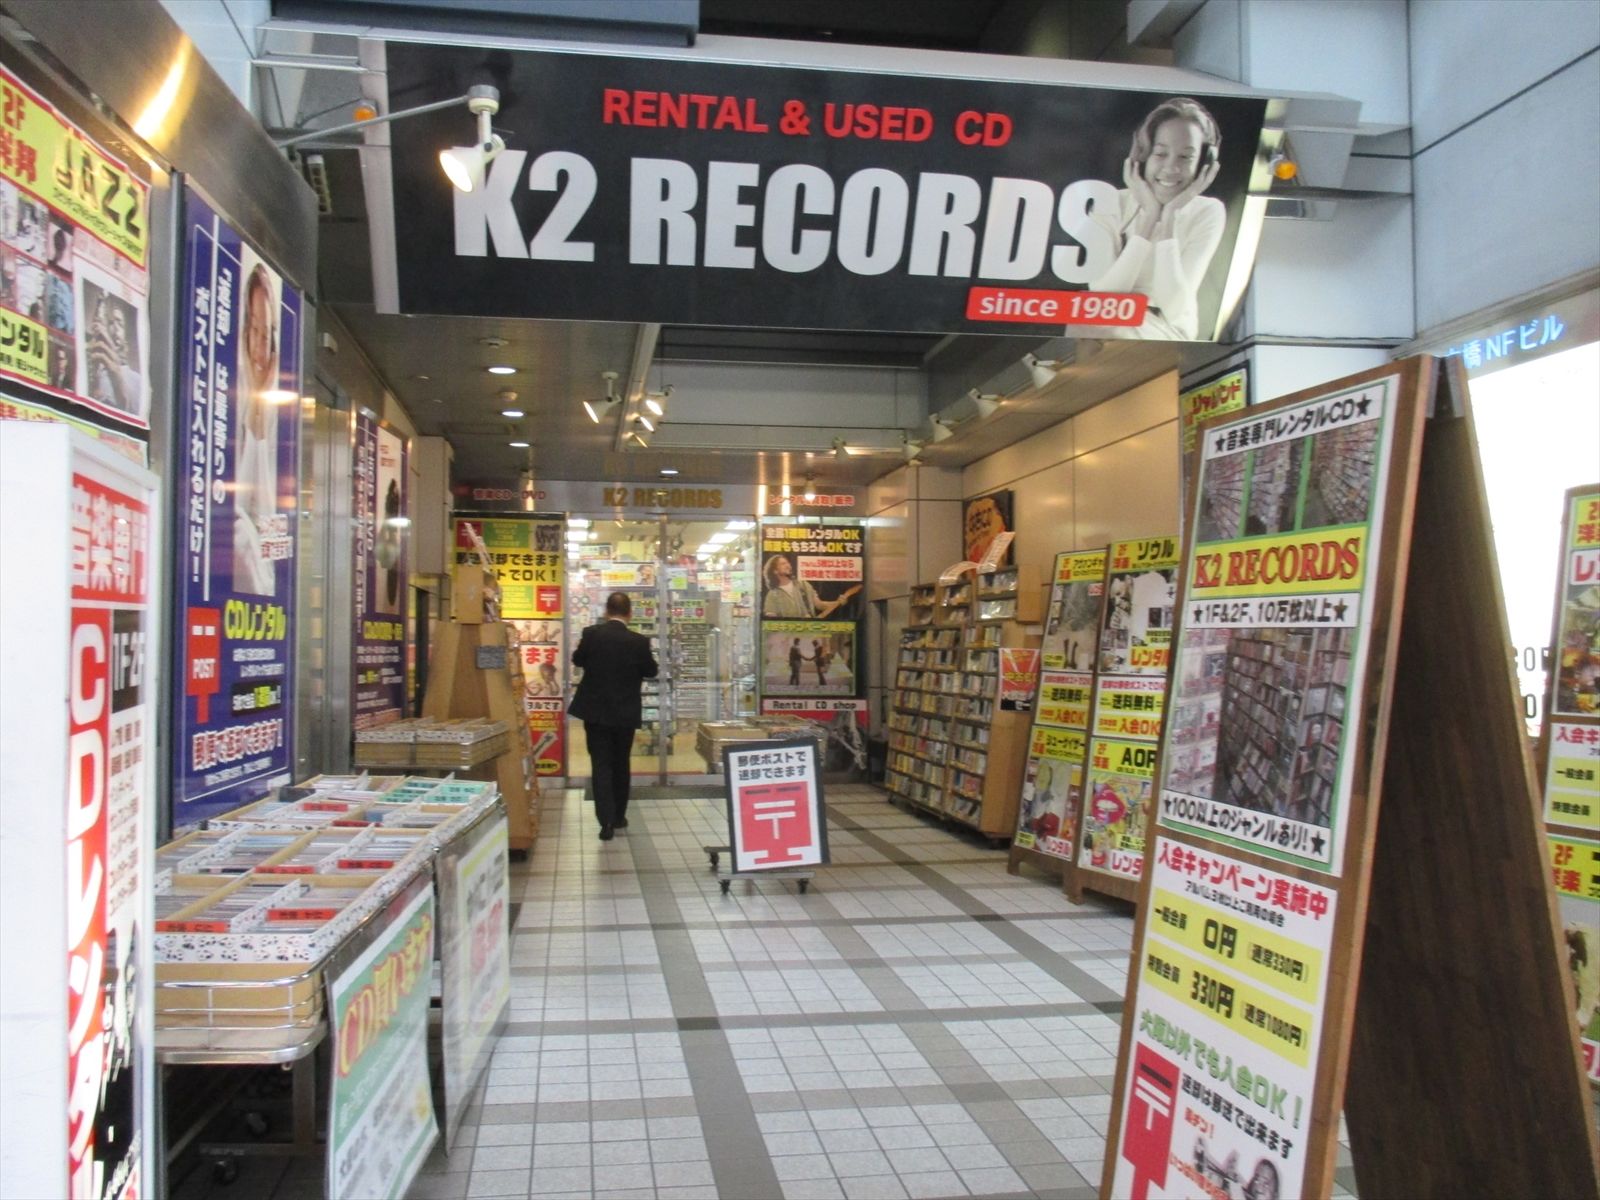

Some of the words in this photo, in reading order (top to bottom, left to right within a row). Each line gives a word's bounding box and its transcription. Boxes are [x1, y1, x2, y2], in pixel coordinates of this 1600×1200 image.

[603, 87, 768, 136] RENTAL
[780, 99, 809, 137] &
[825, 103, 933, 143] USED
[955, 111, 1012, 147] CD
[452, 148, 598, 262] K2
[629, 157, 1118, 284] RECORDS
[979, 290, 1058, 318] since
[1070, 296, 1137, 322] 1980
[603, 488, 628, 507] K2
[634, 488, 723, 509] RECORDS
[1136, 539, 1175, 561] ソウル
[1193, 553, 1222, 588] K2
[1225, 536, 1361, 587] RECORDS
[192, 658, 216, 680] POST
[738, 751, 807, 767] 郵便ポストで
[1158, 842, 1329, 921] 入会キャンペーン実施中
[1203, 917, 1238, 959] 0円
[1191, 969, 1235, 1019] 330円
